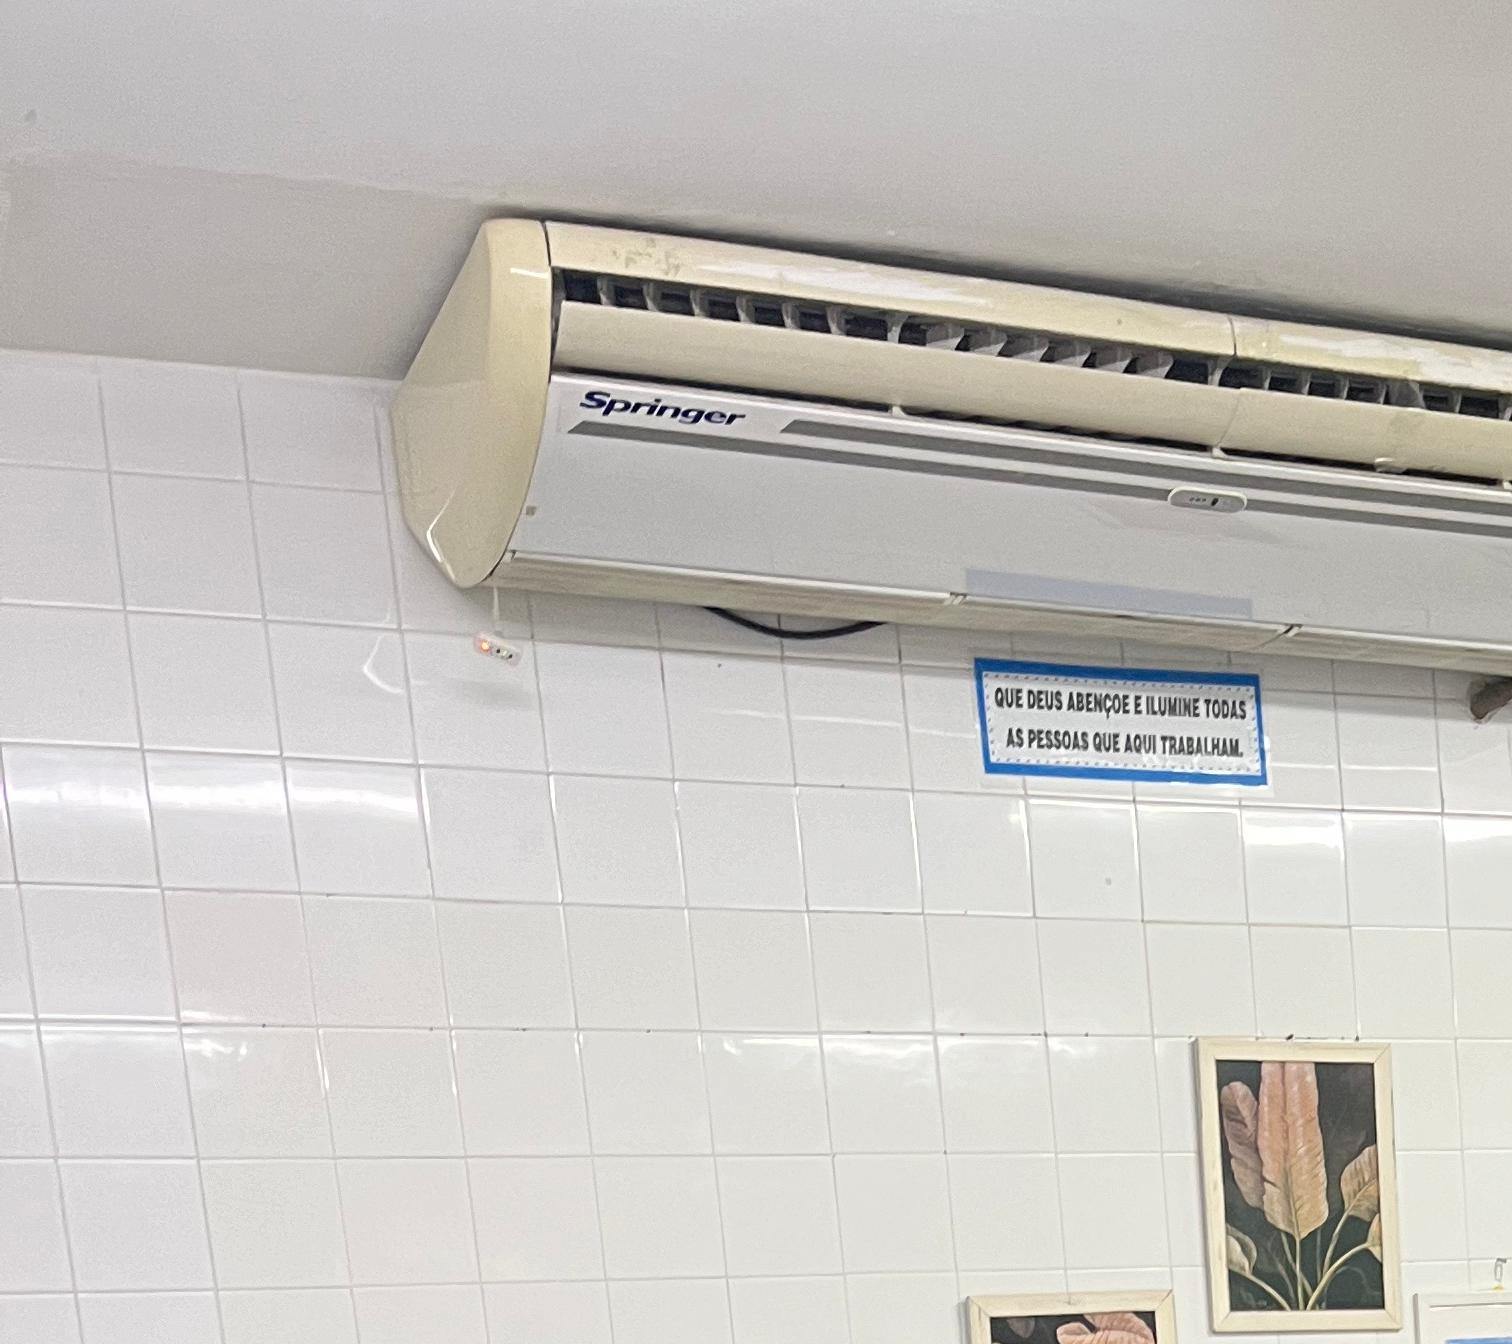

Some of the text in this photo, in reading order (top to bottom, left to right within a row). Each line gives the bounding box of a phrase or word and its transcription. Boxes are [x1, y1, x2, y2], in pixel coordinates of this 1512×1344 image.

[579, 390, 747, 425] Springer
[994, 687, 1248, 720] QUE DEUS ABENÇOE E ILUMINE TODAS
[1006, 728, 1244, 757] AS PESSOAS QUE AQUI TRABALHAM.
